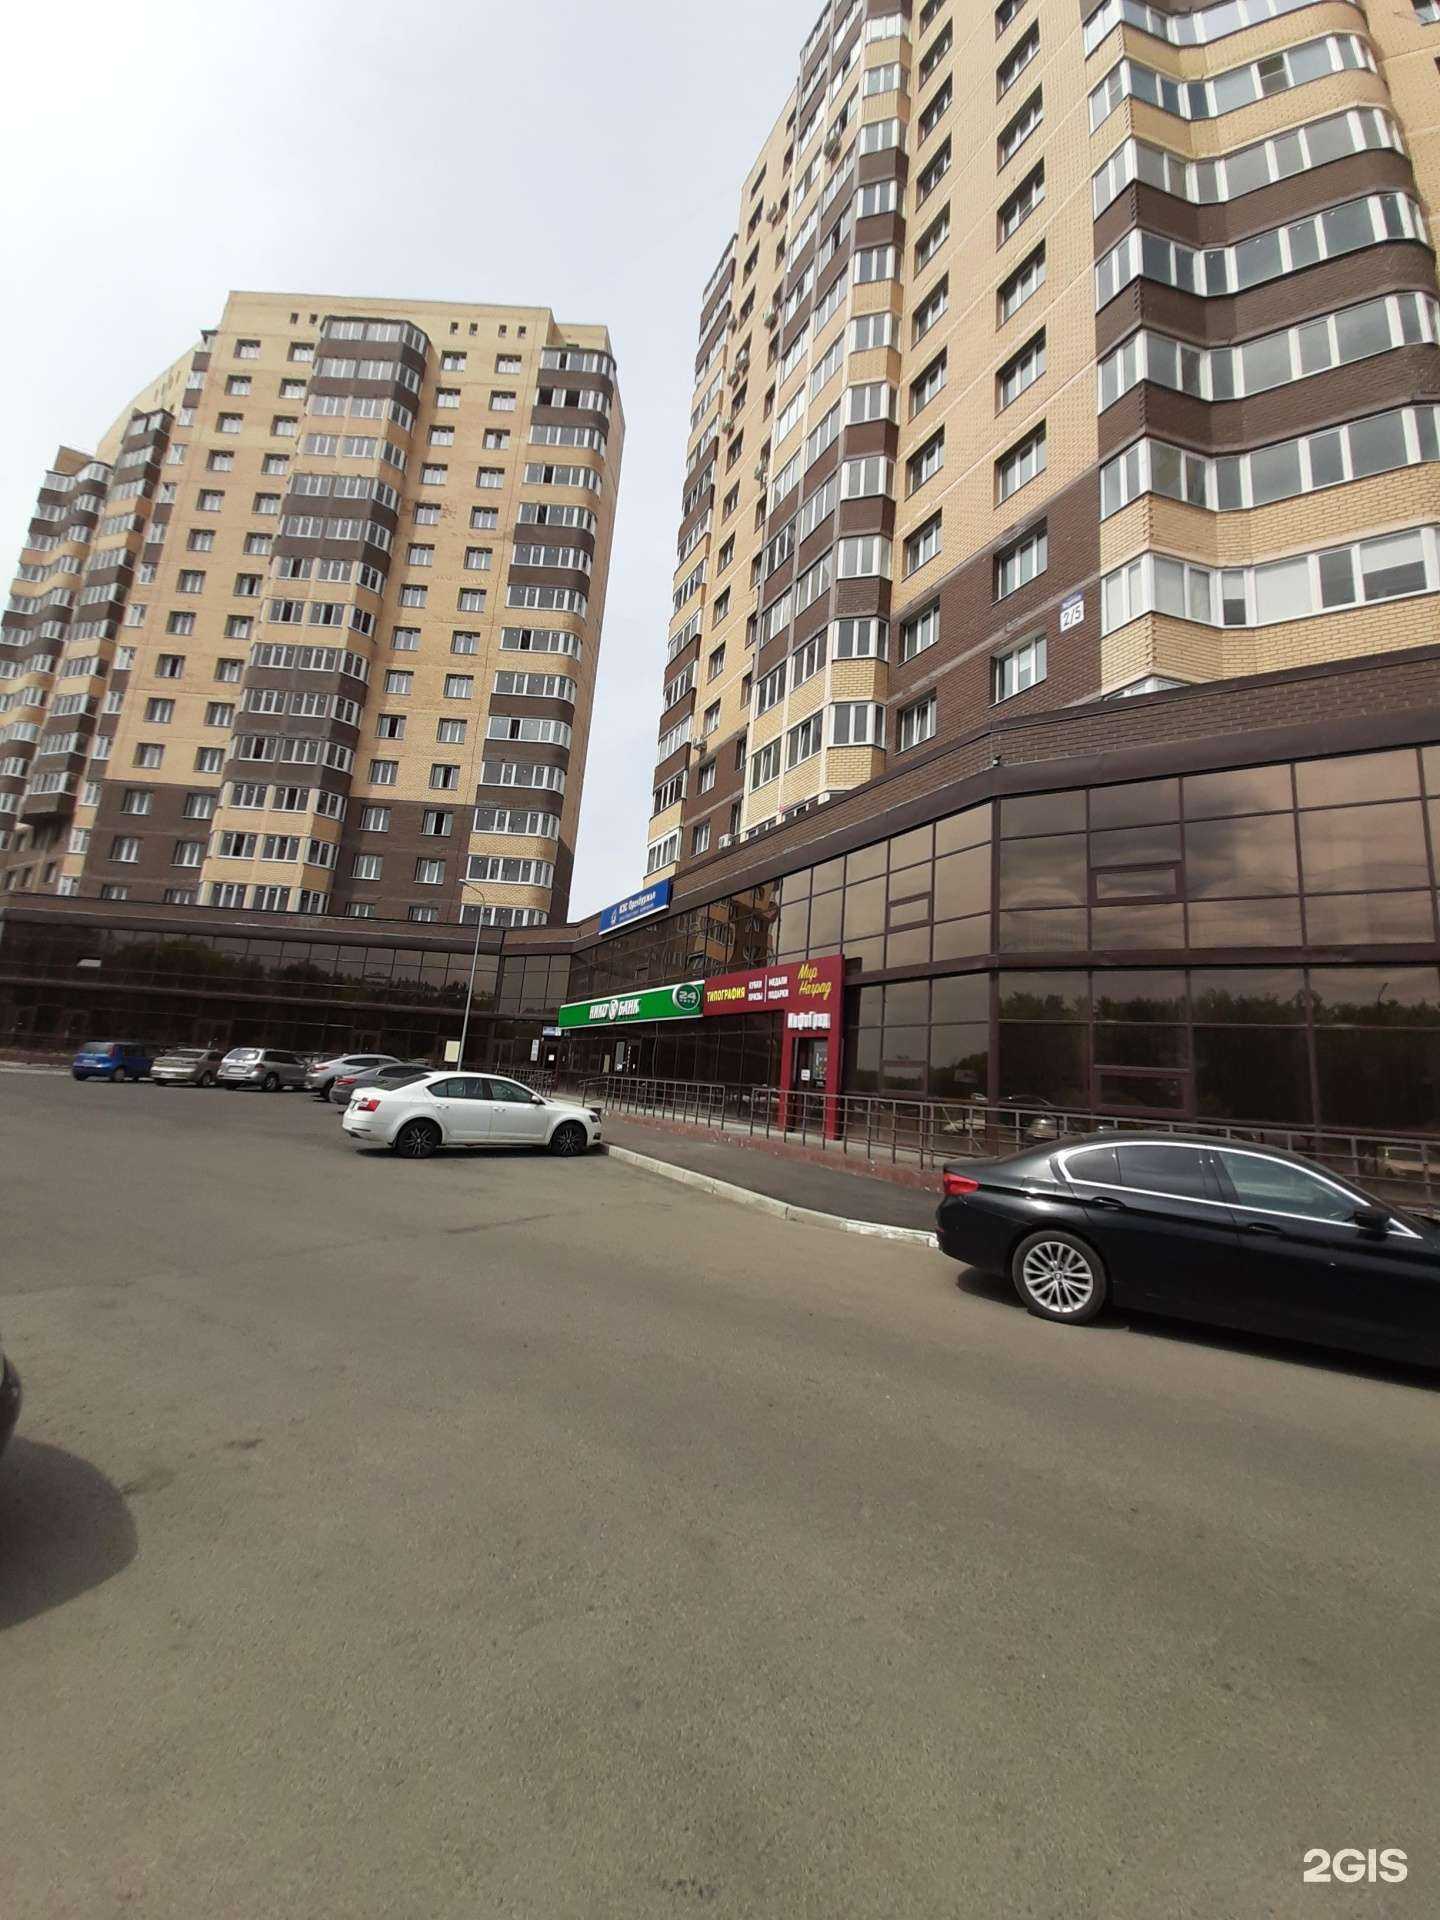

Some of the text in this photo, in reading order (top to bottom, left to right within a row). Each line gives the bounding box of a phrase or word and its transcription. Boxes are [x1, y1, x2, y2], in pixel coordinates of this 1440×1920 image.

[1063, 605, 1081, 627] 2/5
[798, 963, 818, 980] Мир
[679, 991, 696, 1000] 24
[706, 987, 746, 1002] ТИПОГРАФИЯ
[799, 981, 832, 1000] Наград
[618, 998, 642, 1016] БАНК
